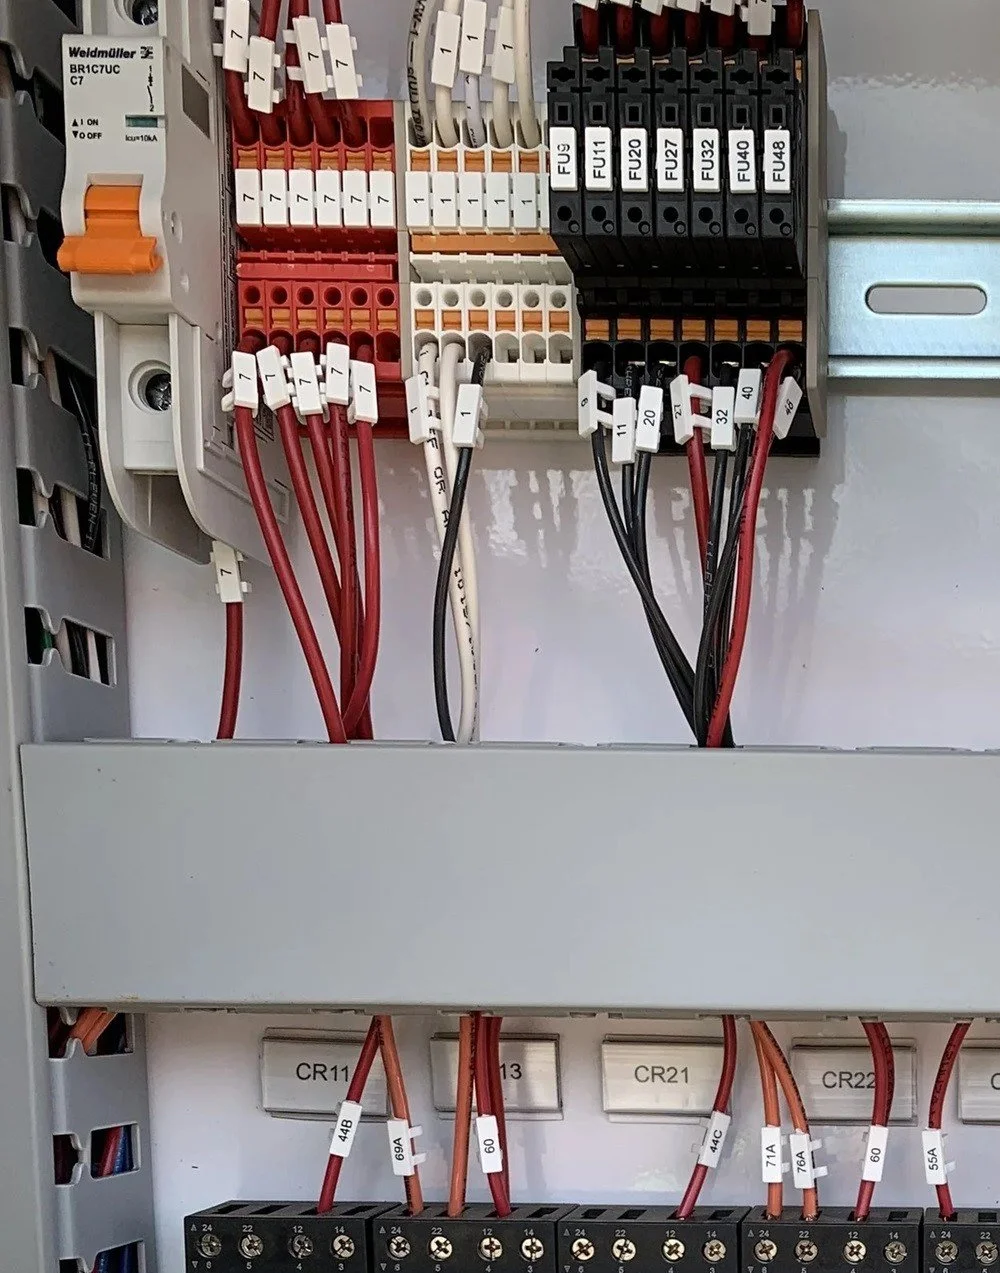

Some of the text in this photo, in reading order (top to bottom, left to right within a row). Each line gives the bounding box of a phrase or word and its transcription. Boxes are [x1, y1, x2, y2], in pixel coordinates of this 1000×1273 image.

[231, 30, 243, 39] 7
[69, 47, 136, 59] Weidmüller
[70, 64, 120, 74] BR1C7UC
[335, 58, 349, 70] 7
[70, 76, 84, 85] C7
[149, 104, 154, 112] 2
[557, 144, 570, 175] FU9
[593, 141, 606, 179] FU11
[628, 139, 641, 180] FU20
[665, 139, 678, 180] FU27
[701, 140, 714, 181] FU32
[736, 141, 750, 182] FU40
[772, 141, 785, 182] FU48
[243, 193, 254, 201] 7
[270, 194, 281, 202] 7
[378, 196, 389, 204] 7
[742, 387, 753, 400] 40
[716, 410, 728, 424] 32
[785, 399, 795, 417] 48
[643, 410, 656, 426] 20
[617, 424, 626, 437] 11
[296, 1062, 349, 1082] CR11
[634, 1065, 689, 1084] CR21
[822, 1070, 876, 1089] CR22
[339, 1119, 352, 1142] 44B
[393, 1138, 404, 1161] 69A
[483, 1139, 495, 1154] 60
[710, 1130, 722, 1153] 44C
[766, 1144, 776, 1167] 71A
[796, 1151, 806, 1173] 76A
[870, 1148, 881, 1162] 60
[927, 1148, 938, 1170] 55A
